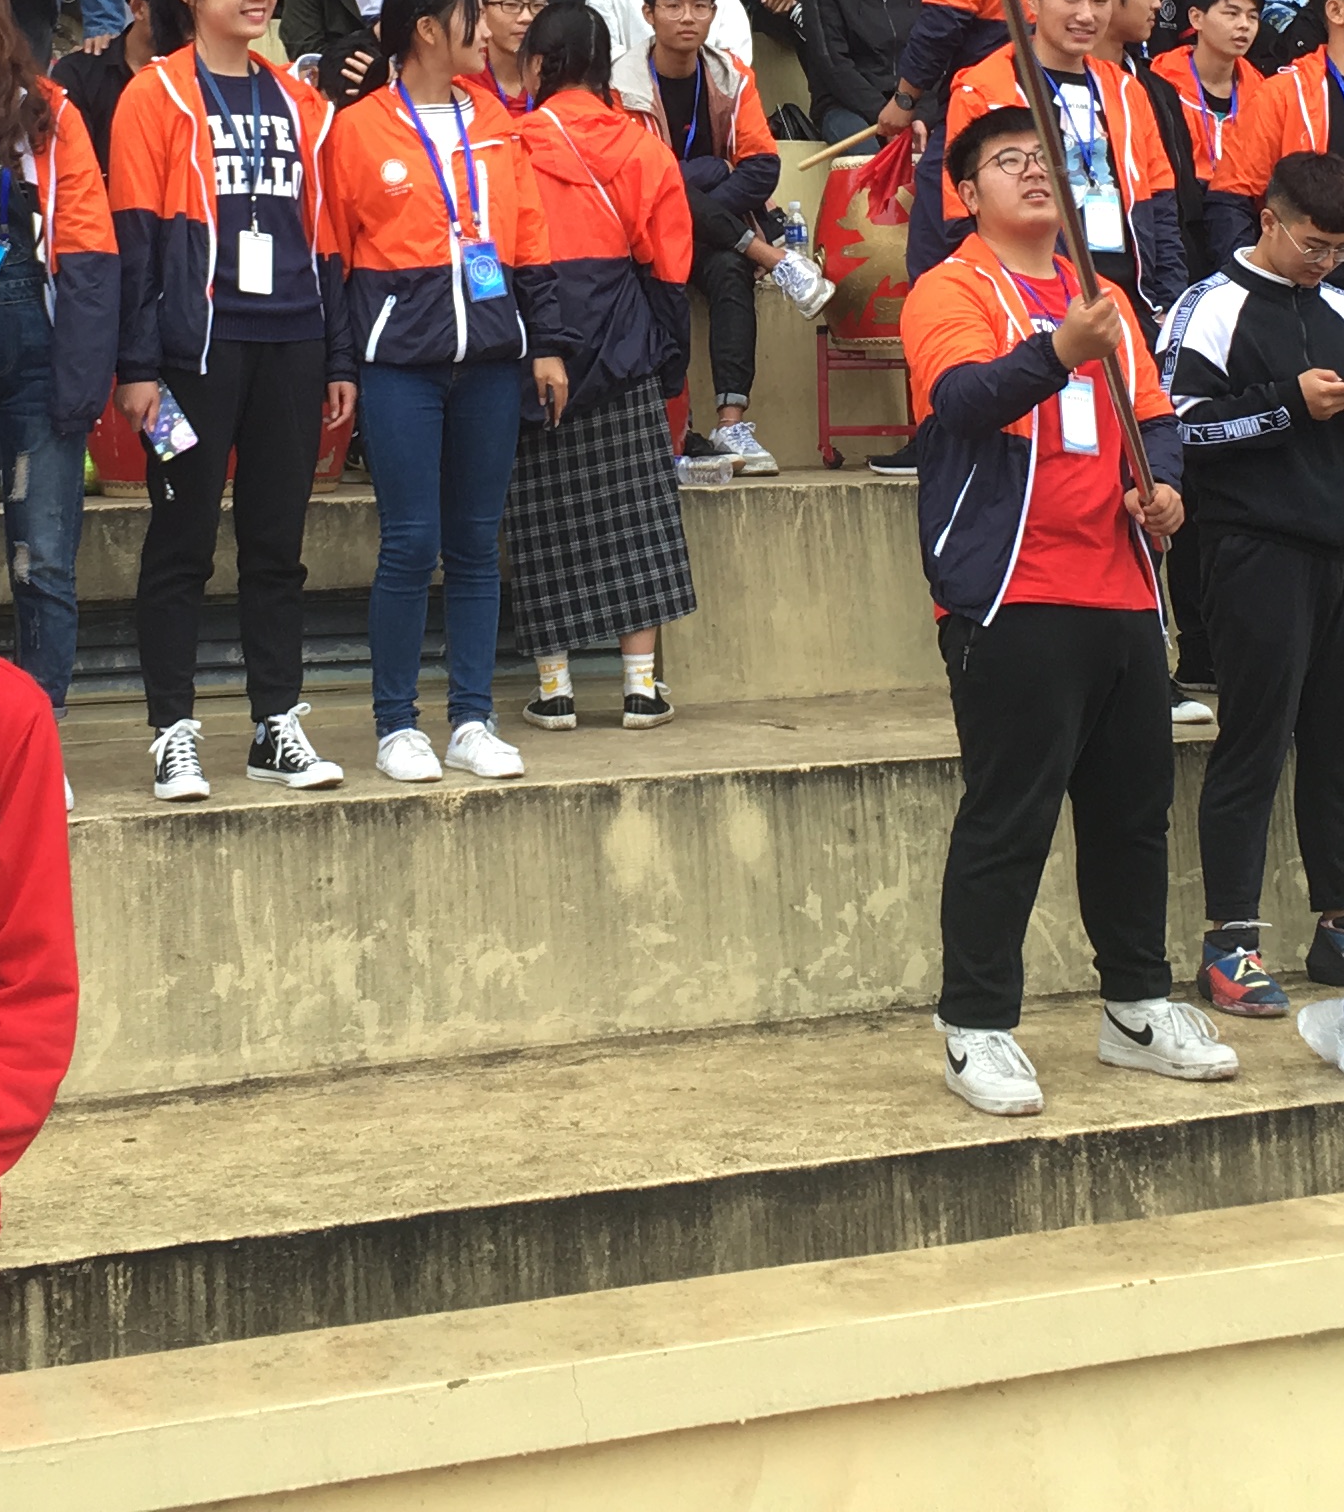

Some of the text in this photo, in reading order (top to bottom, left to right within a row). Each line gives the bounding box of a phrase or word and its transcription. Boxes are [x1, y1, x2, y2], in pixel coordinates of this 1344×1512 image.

[207, 114, 296, 153] LIFE
[212, 155, 304, 201] HELLO
[1223, 418, 1261, 439] PUMA
